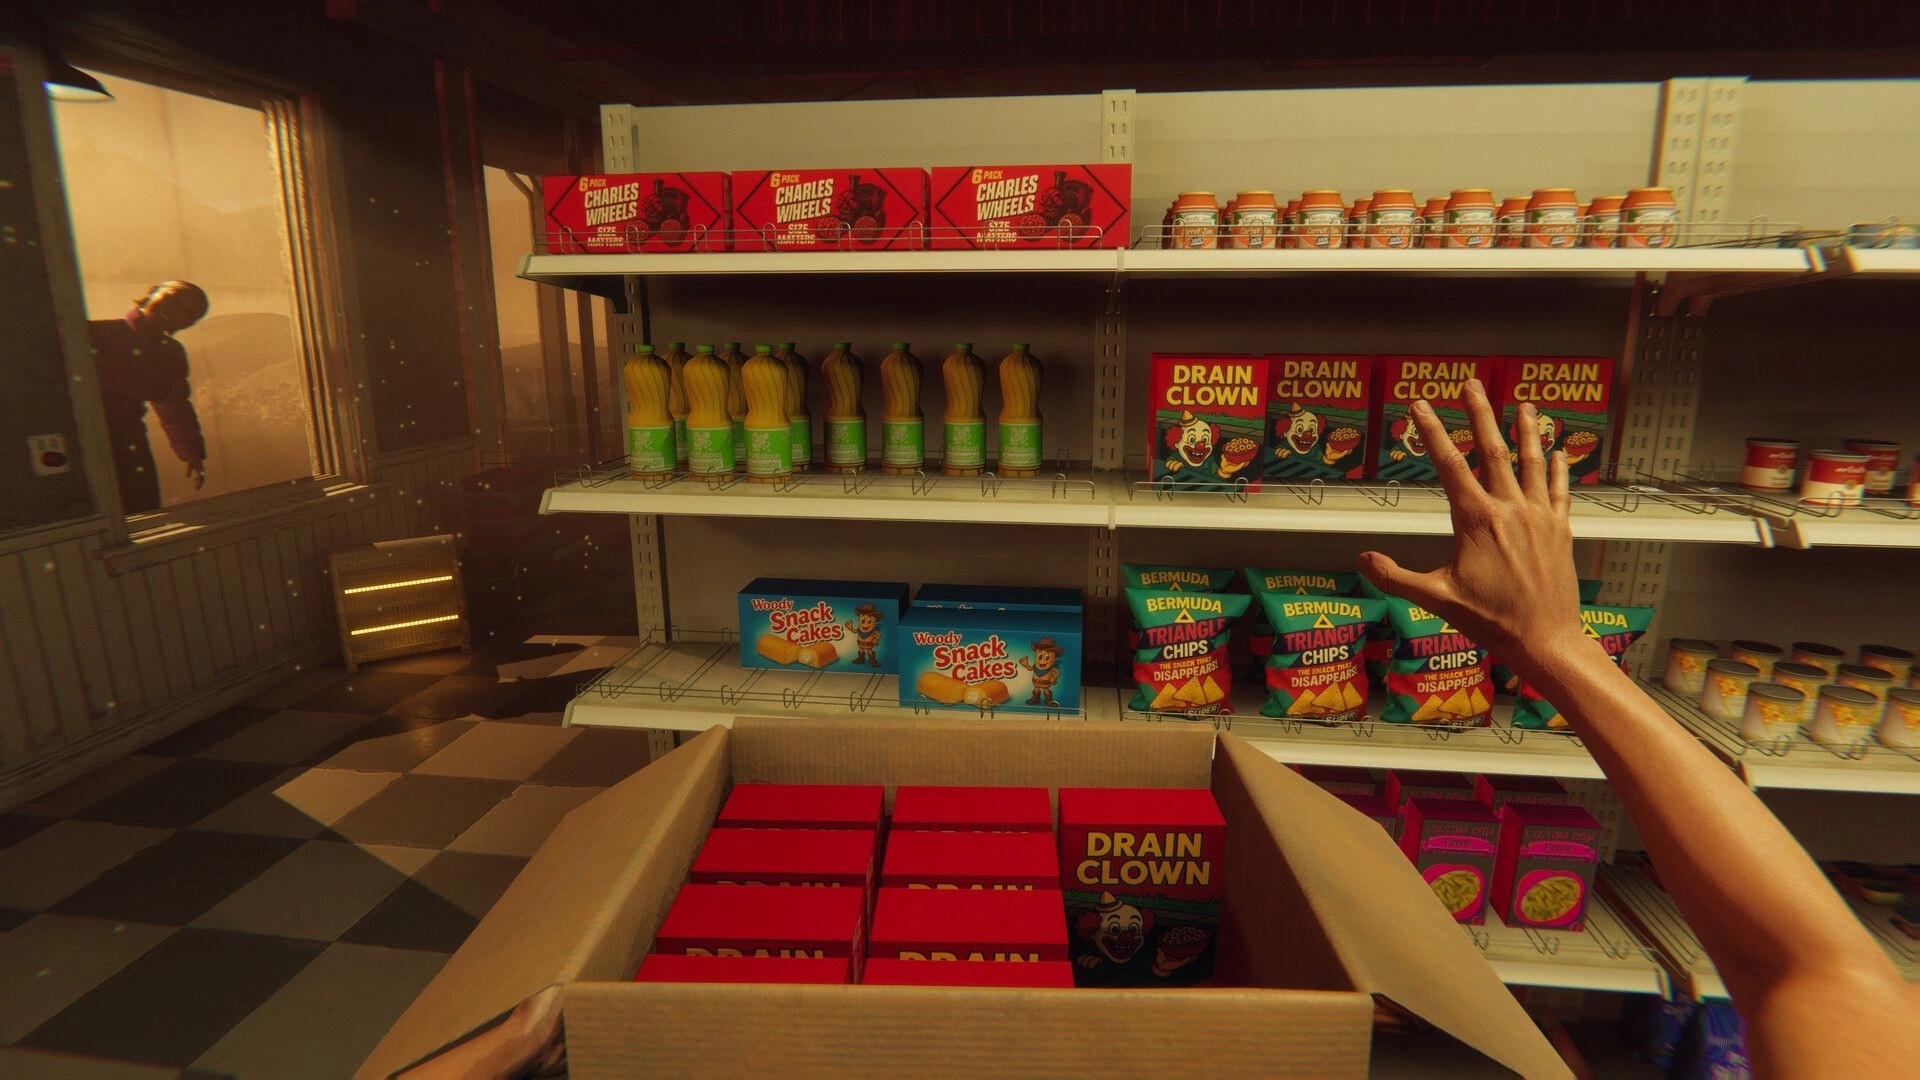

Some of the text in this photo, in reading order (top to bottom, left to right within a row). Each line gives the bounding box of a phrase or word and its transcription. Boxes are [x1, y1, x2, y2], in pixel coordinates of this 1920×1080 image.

[579, 177, 606, 192] 6 PACK
[770, 173, 800, 188] 6 PACK
[972, 169, 1003, 184] 6 PACK
[584, 182, 639, 208] CHARLES
[776, 178, 834, 205] CHARLES
[976, 175, 1038, 202] CHARLES
[586, 201, 638, 226] WHEELS
[777, 198, 832, 224] WHEELS
[978, 194, 1036, 221] WHEELS
[598, 226, 616, 236] SIZE
[788, 224, 808, 234] SIZE
[989, 221, 1010, 232] SIZE
[588, 237, 624, 247] MATTERS
[778, 234, 816, 244] MATTERS
[1174, 365, 1252, 384] DRAIN
[1284, 360, 1357, 378] DRAIN
[1401, 362, 1476, 380] DRAIN
[1522, 363, 1598, 381] DRAIN
[1166, 386, 1258, 406] CLOWN
[1276, 380, 1362, 398] CLOWN
[1394, 382, 1465, 400] CLOW
[1514, 384, 1602, 402] CLOWN
[1141, 570, 1210, 586] BERMUDA
[1265, 575, 1336, 591] BERMUDA
[752, 598, 794, 611] Woody
[1146, 597, 1222, 614] BERMUDA
[1283, 601, 1362, 618] BERMUDA
[770, 601, 833, 632] Snack
[1580, 610, 1628, 628] MUDA
[786, 624, 844, 645] Cakes
[914, 632, 962, 646] Woody
[934, 634, 1006, 669] Snack
[1164, 641, 1208, 660] CHIPS
[1410, 634, 1477, 657] TRIAN
[1160, 656, 1212, 670] THE SNACK THAT
[1302, 646, 1349, 666] CHIPS
[1429, 650, 1478, 671] CHIPS
[952, 660, 1016, 684] Cakes
[1154, 660, 1219, 682] DISAPPEARS!
[1298, 662, 1352, 676] THE SNACK THAT
[1424, 666, 1480, 682] THE SNACK THAT
[1087, 832, 1202, 857] DRAIN
[1076, 860, 1211, 886] CLOWN
